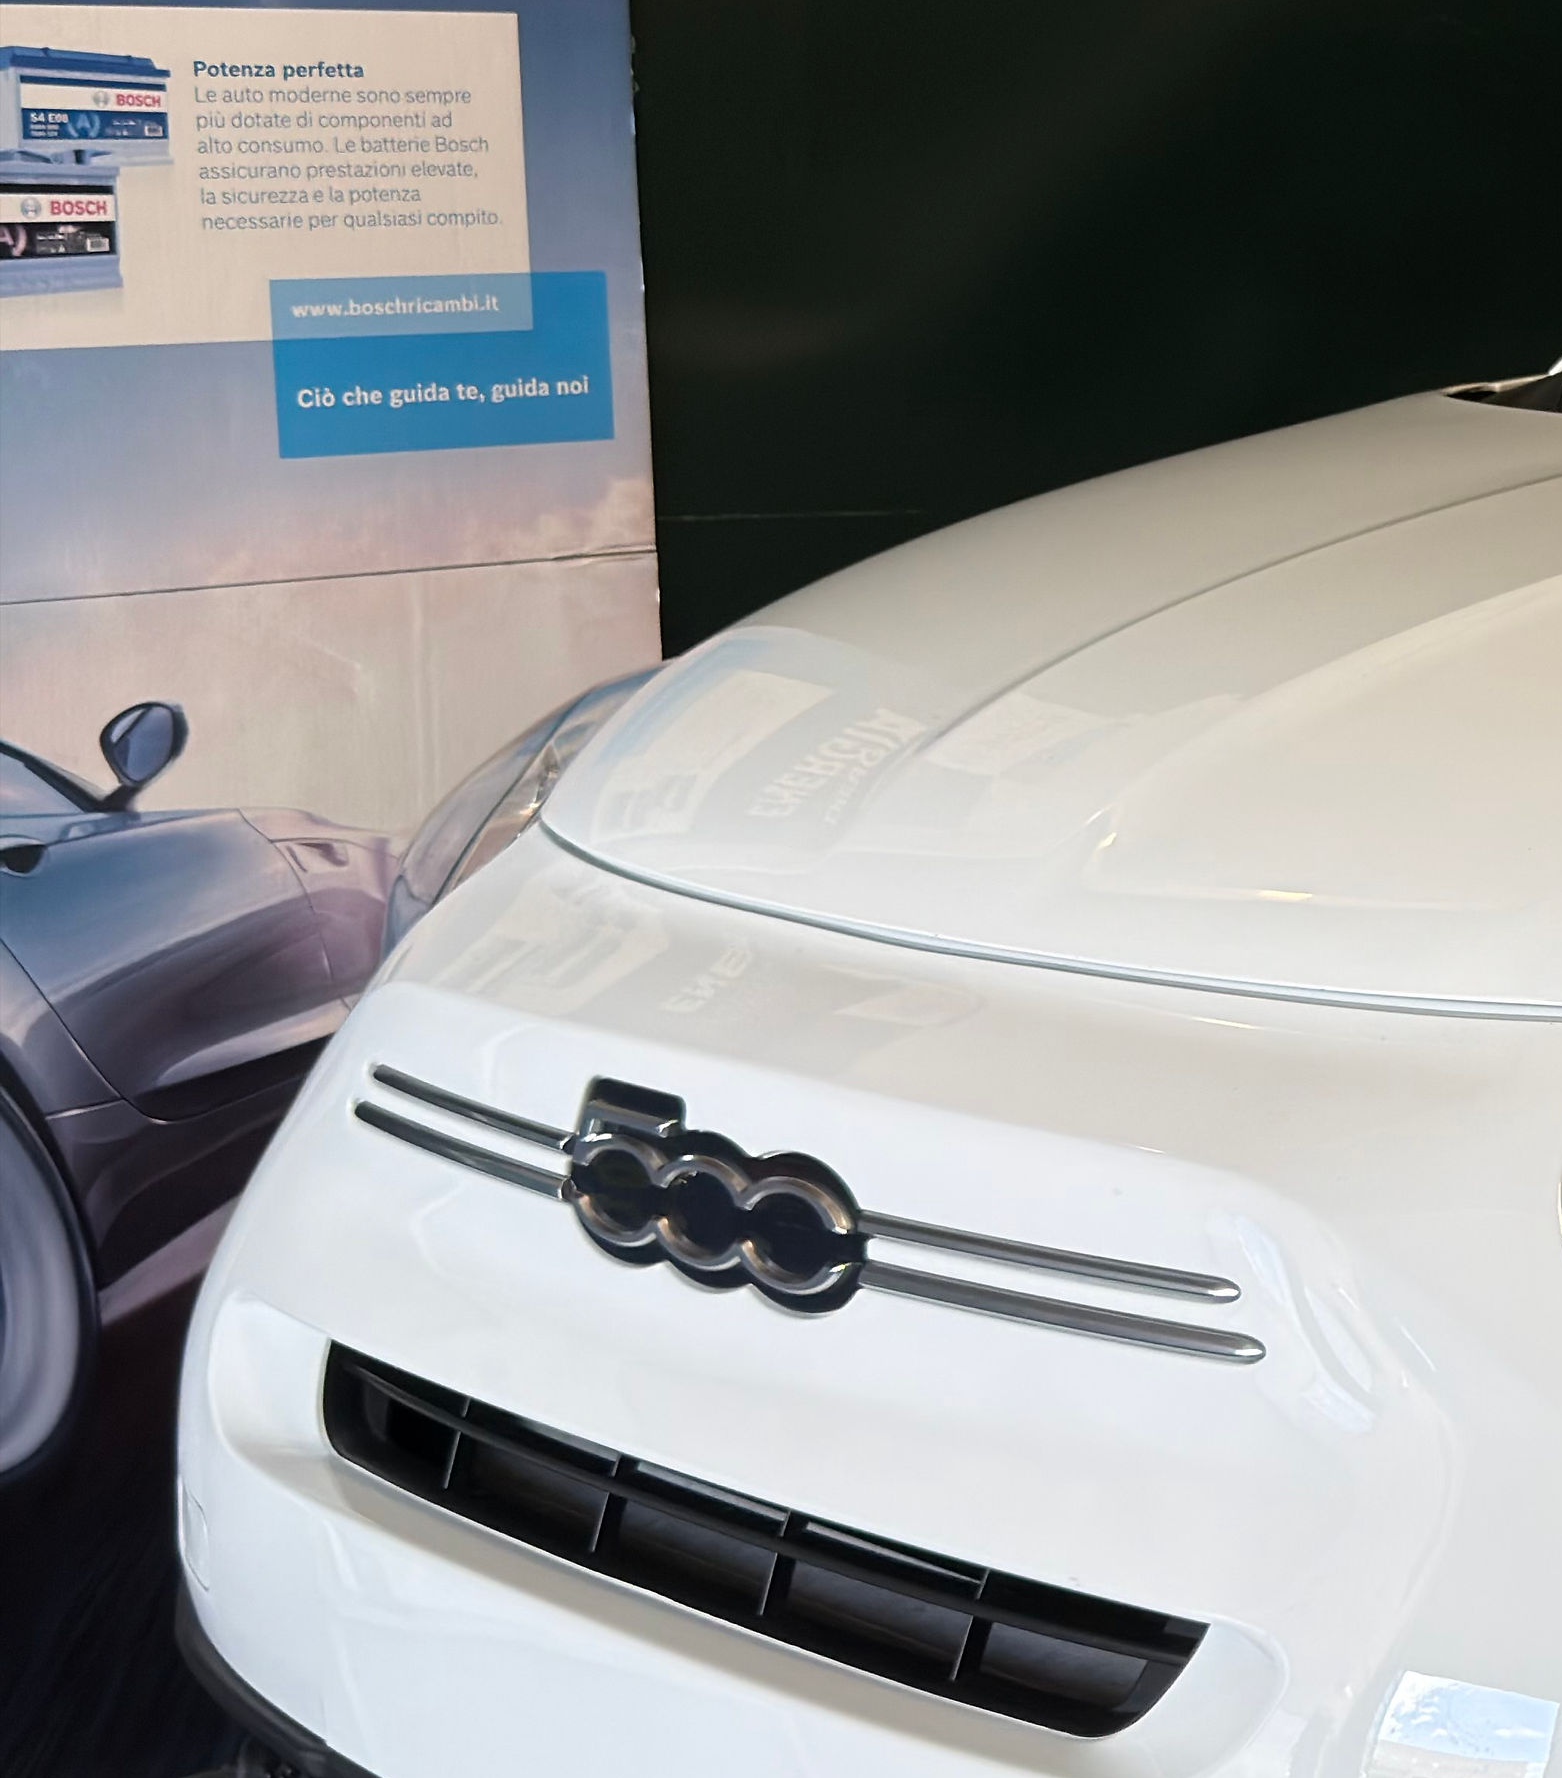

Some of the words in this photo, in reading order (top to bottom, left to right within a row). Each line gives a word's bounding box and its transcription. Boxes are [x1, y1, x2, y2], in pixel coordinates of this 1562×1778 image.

[193, 60, 276, 78] Potenza
[283, 62, 364, 82] perfetta
[116, 93, 161, 107] BOSCH
[194, 86, 217, 103] Le
[222, 89, 263, 104] auto
[269, 86, 351, 104] moderne
[357, 90, 400, 104] sono
[405, 89, 472, 108] sempre
[196, 111, 225, 131] più
[231, 111, 291, 129] dotate
[296, 110, 313, 128] di
[318, 110, 426, 132] componenti
[431, 110, 453, 129] ad
[197, 137, 233, 155] alto
[238, 140, 328, 154] consumo.
[333, 137, 356, 154] Le
[361, 137, 430, 154] batterie
[436, 136, 489, 154] Bosch
[199, 164, 301, 180] assicurano
[306, 162, 406, 183] prestazioni
[411, 162, 478, 179] elevate,
[200, 188, 216, 205] la
[222, 189, 309, 205] sicurezza
[313, 190, 324, 203] e
[329, 186, 345, 203] la
[350, 187, 421, 206] potenza
[50, 199, 108, 216] BOSCH
[201, 214, 302, 231] necessarie
[308, 213, 338, 232] per
[344, 210, 422, 231] qualsiasi
[427, 208, 503, 229] compito.
[291, 295, 500, 318] www.boschricambi.it
[297, 387, 336, 409] Ciò
[343, 385, 383, 407] che
[390, 381, 450, 409] guida
[456, 380, 486, 404] te,
[492, 377, 550, 403] guida
[557, 374, 590, 396] noi
[569, 1075, 868, 1315] 500
